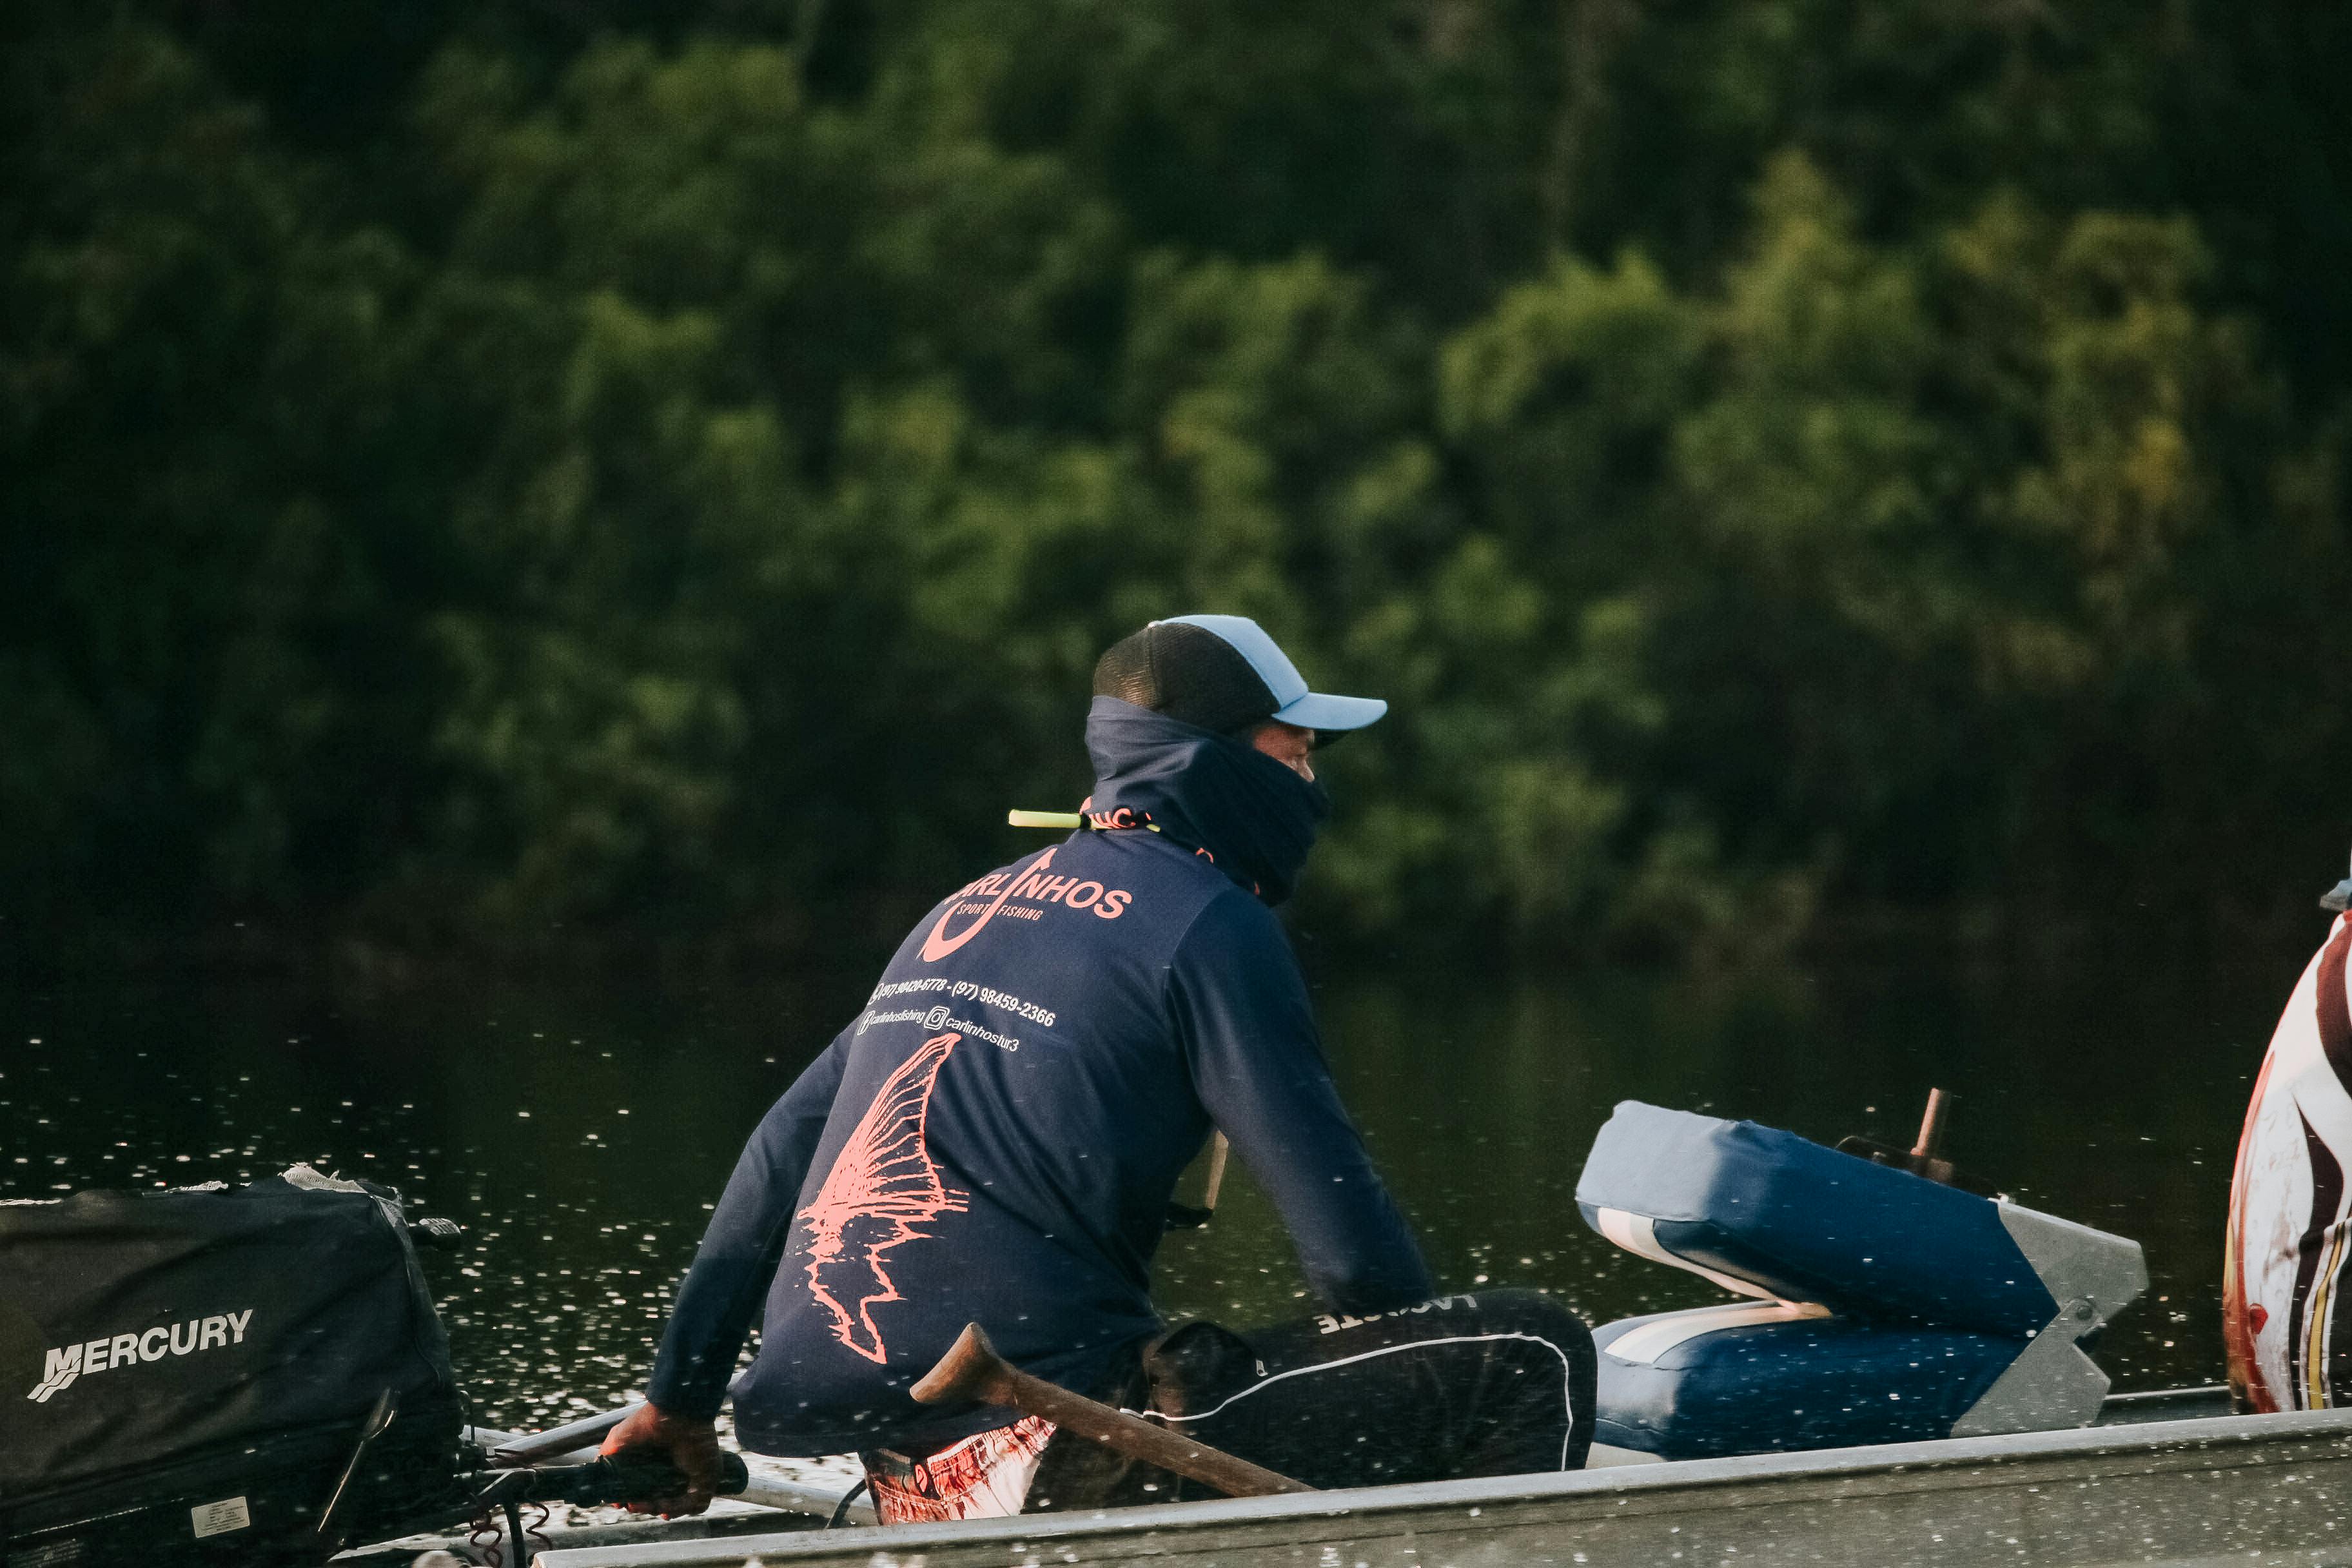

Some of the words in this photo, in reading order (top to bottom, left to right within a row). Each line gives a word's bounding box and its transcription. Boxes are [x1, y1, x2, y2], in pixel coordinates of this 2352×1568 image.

[957, 903, 991, 915] SPORT
[997, 905, 1043, 921] FISHING
[951, 981, 978, 1001] (97)
[979, 987, 1056, 1026] 98459-2366
[946, 1017, 1019, 1052] carlinhostur3
[27, 1309, 253, 1402] MERCURY
